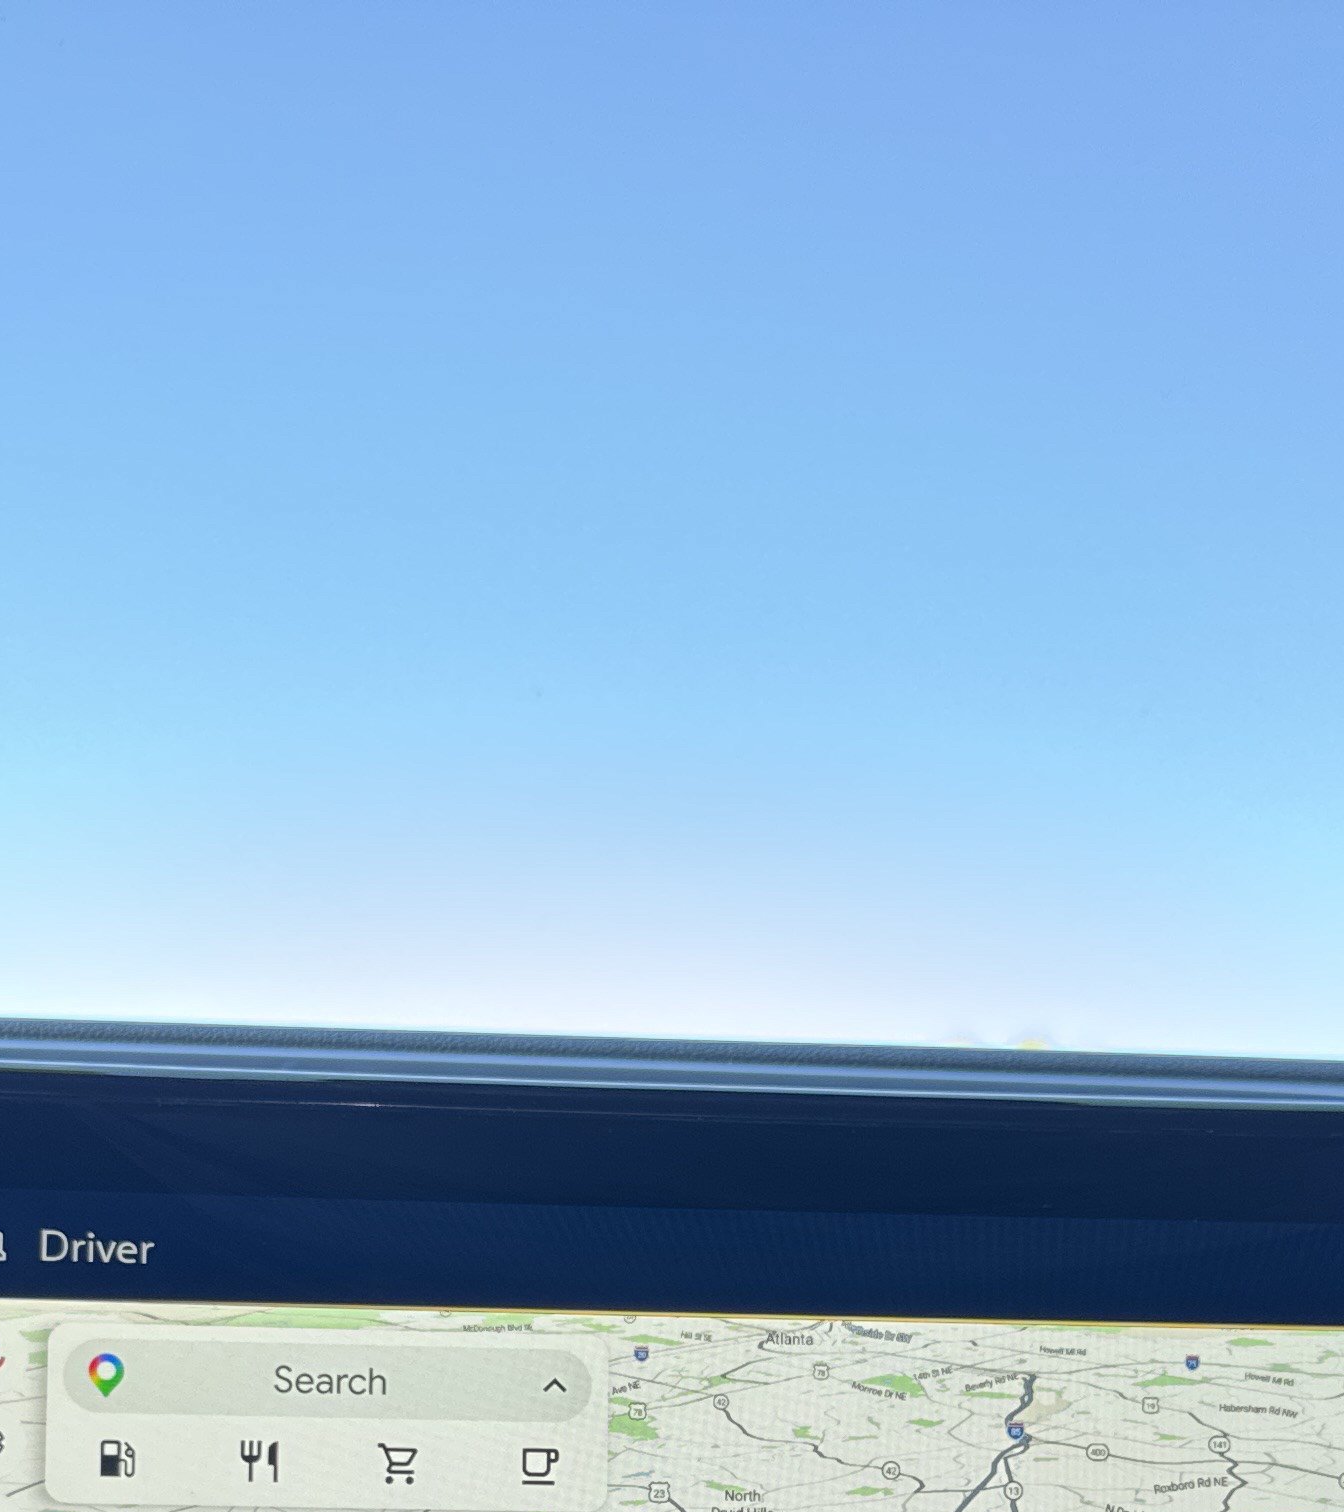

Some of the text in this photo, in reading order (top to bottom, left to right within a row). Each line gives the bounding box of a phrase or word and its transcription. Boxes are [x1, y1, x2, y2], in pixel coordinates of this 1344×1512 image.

[39, 1227, 156, 1266] Driver
[765, 1331, 814, 1346] Atlanta
[273, 1364, 388, 1397] Search
[965, 1372, 1019, 1392] Beverly Rd NE
[1245, 1373, 1270, 1383] Howell
[1284, 1378, 1294, 1386] Rd
[851, 1381, 906, 1400] Monroe Dr NE
[634, 1408, 642, 1416] 78
[1219, 1403, 1298, 1419] Habersham Rd NW
[886, 1466, 896, 1475] 42
[1009, 1487, 1019, 1495] 13
[1154, 1477, 1228, 1494] Roxboro Rd NE
[654, 1489, 665, 1499] 23
[724, 1490, 761, 1502] North
